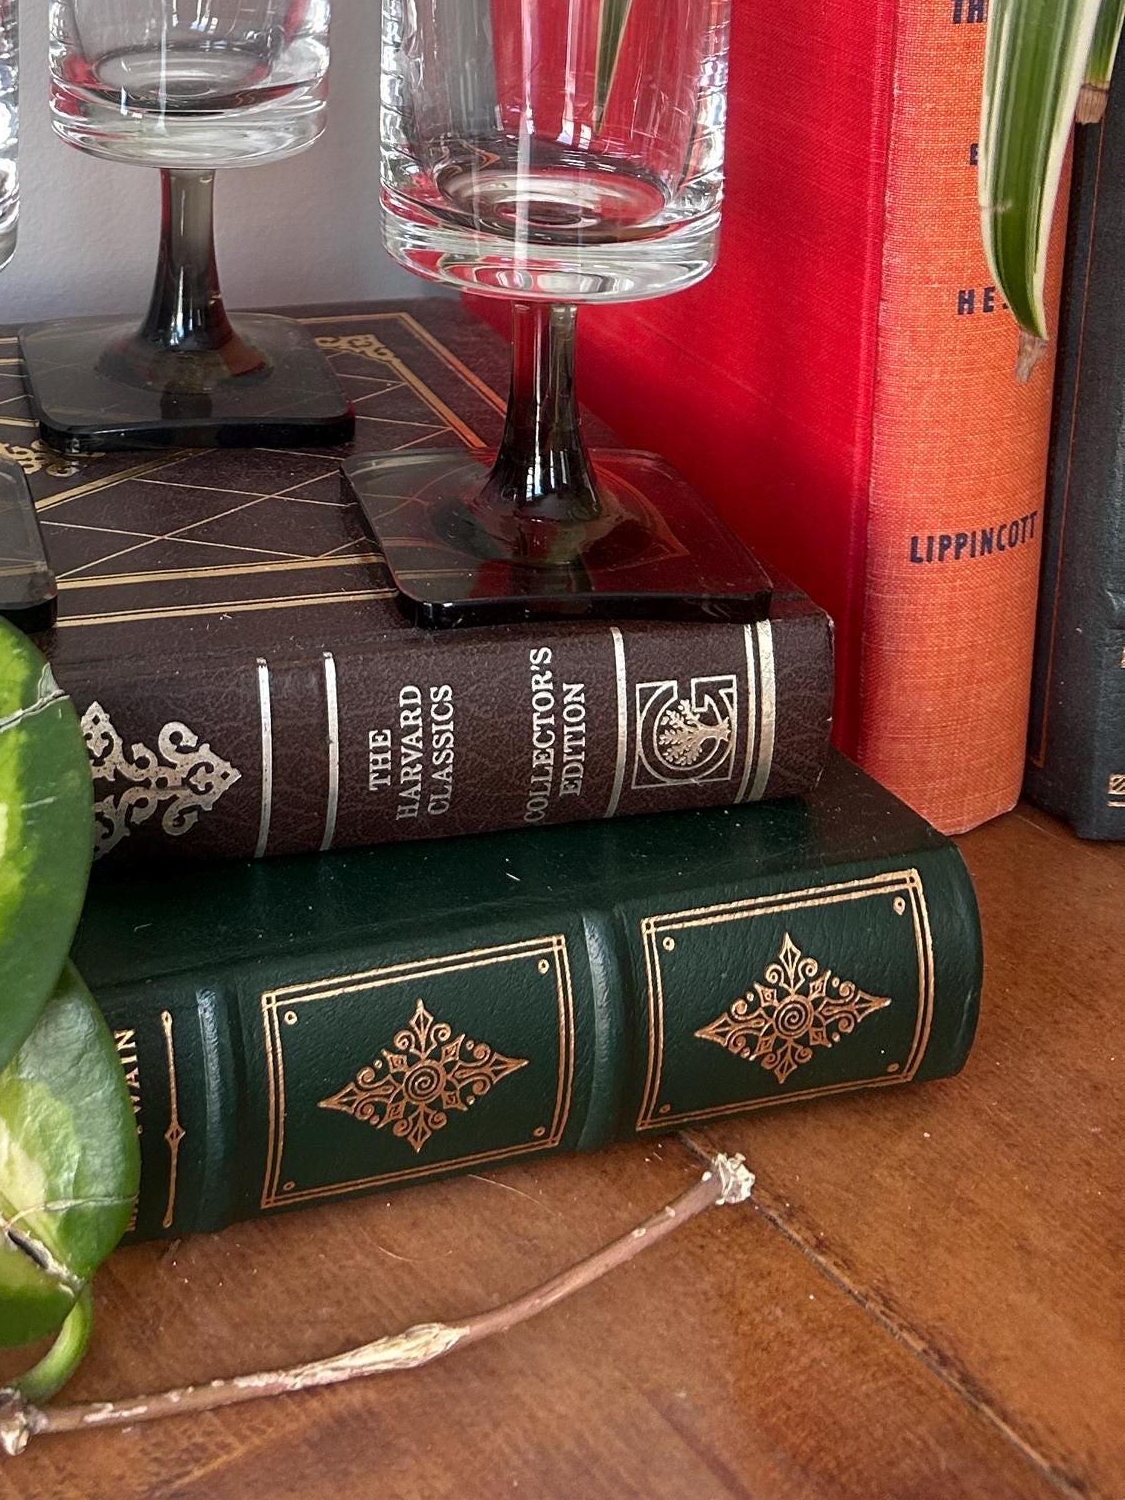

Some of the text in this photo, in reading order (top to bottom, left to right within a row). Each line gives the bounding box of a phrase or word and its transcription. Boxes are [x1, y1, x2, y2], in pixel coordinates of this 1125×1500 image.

[957, 287, 1010, 316] HE
[909, 510, 1038, 564] LIPPINCOTT
[368, 728, 393, 791] THE
[395, 684, 422, 820] HARVARD
[426, 684, 455, 816] CLASSICS
[523, 646, 554, 824] COLLECTOR'S
[560, 682, 587, 796] EDITION
